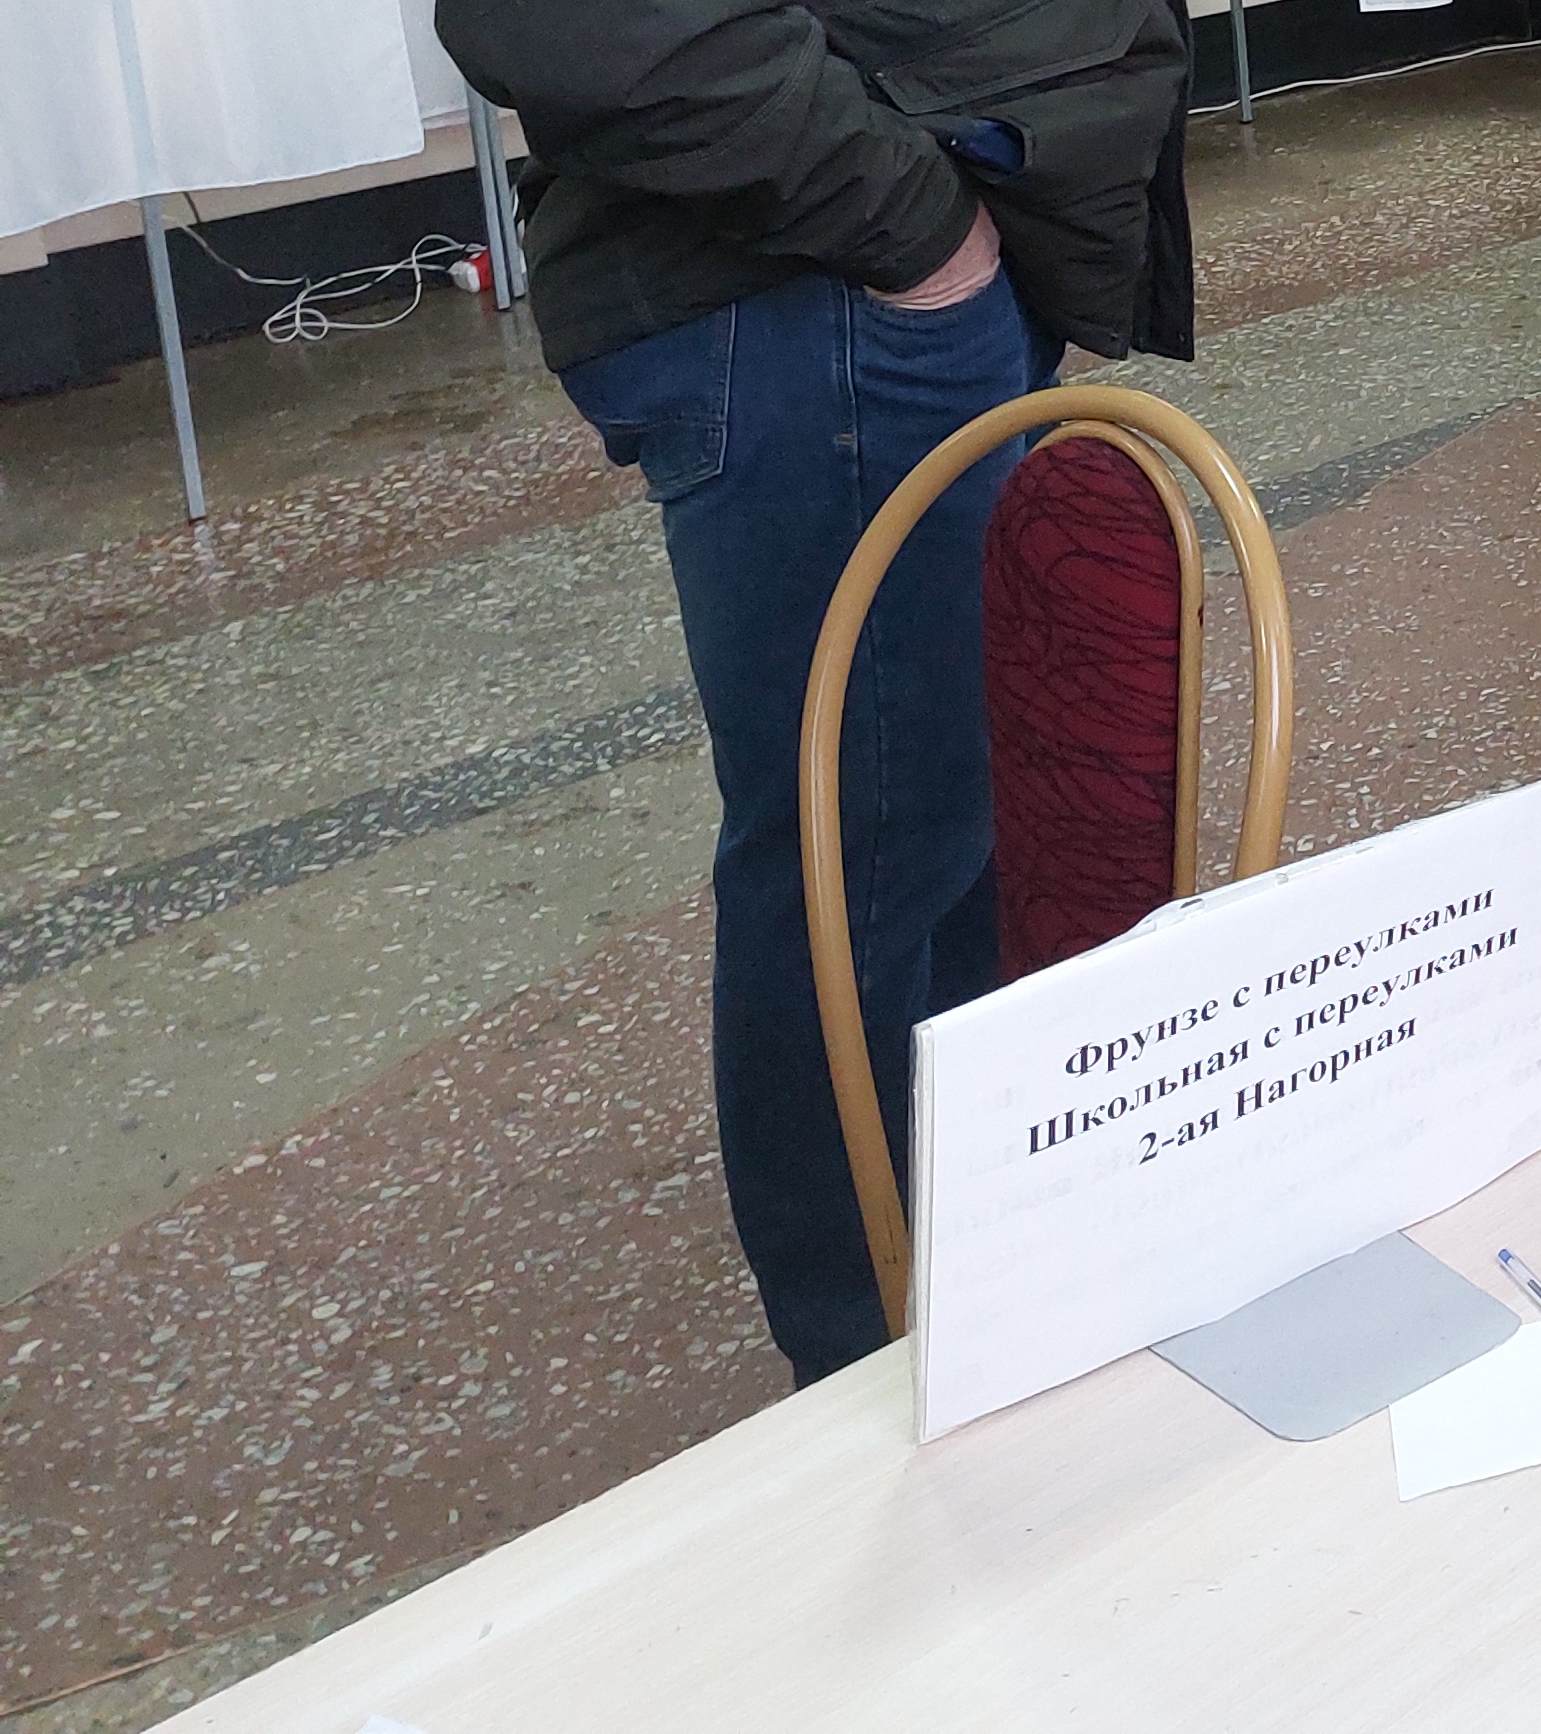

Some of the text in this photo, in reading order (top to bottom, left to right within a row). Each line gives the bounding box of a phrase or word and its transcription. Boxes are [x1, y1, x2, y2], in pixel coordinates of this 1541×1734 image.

[1026, 925, 1519, 1157] Школьная с переулками
[1064, 887, 1496, 1079] Фрунзе с переулками
[1137, 1016, 1418, 1166] 2-ая Нагорная
